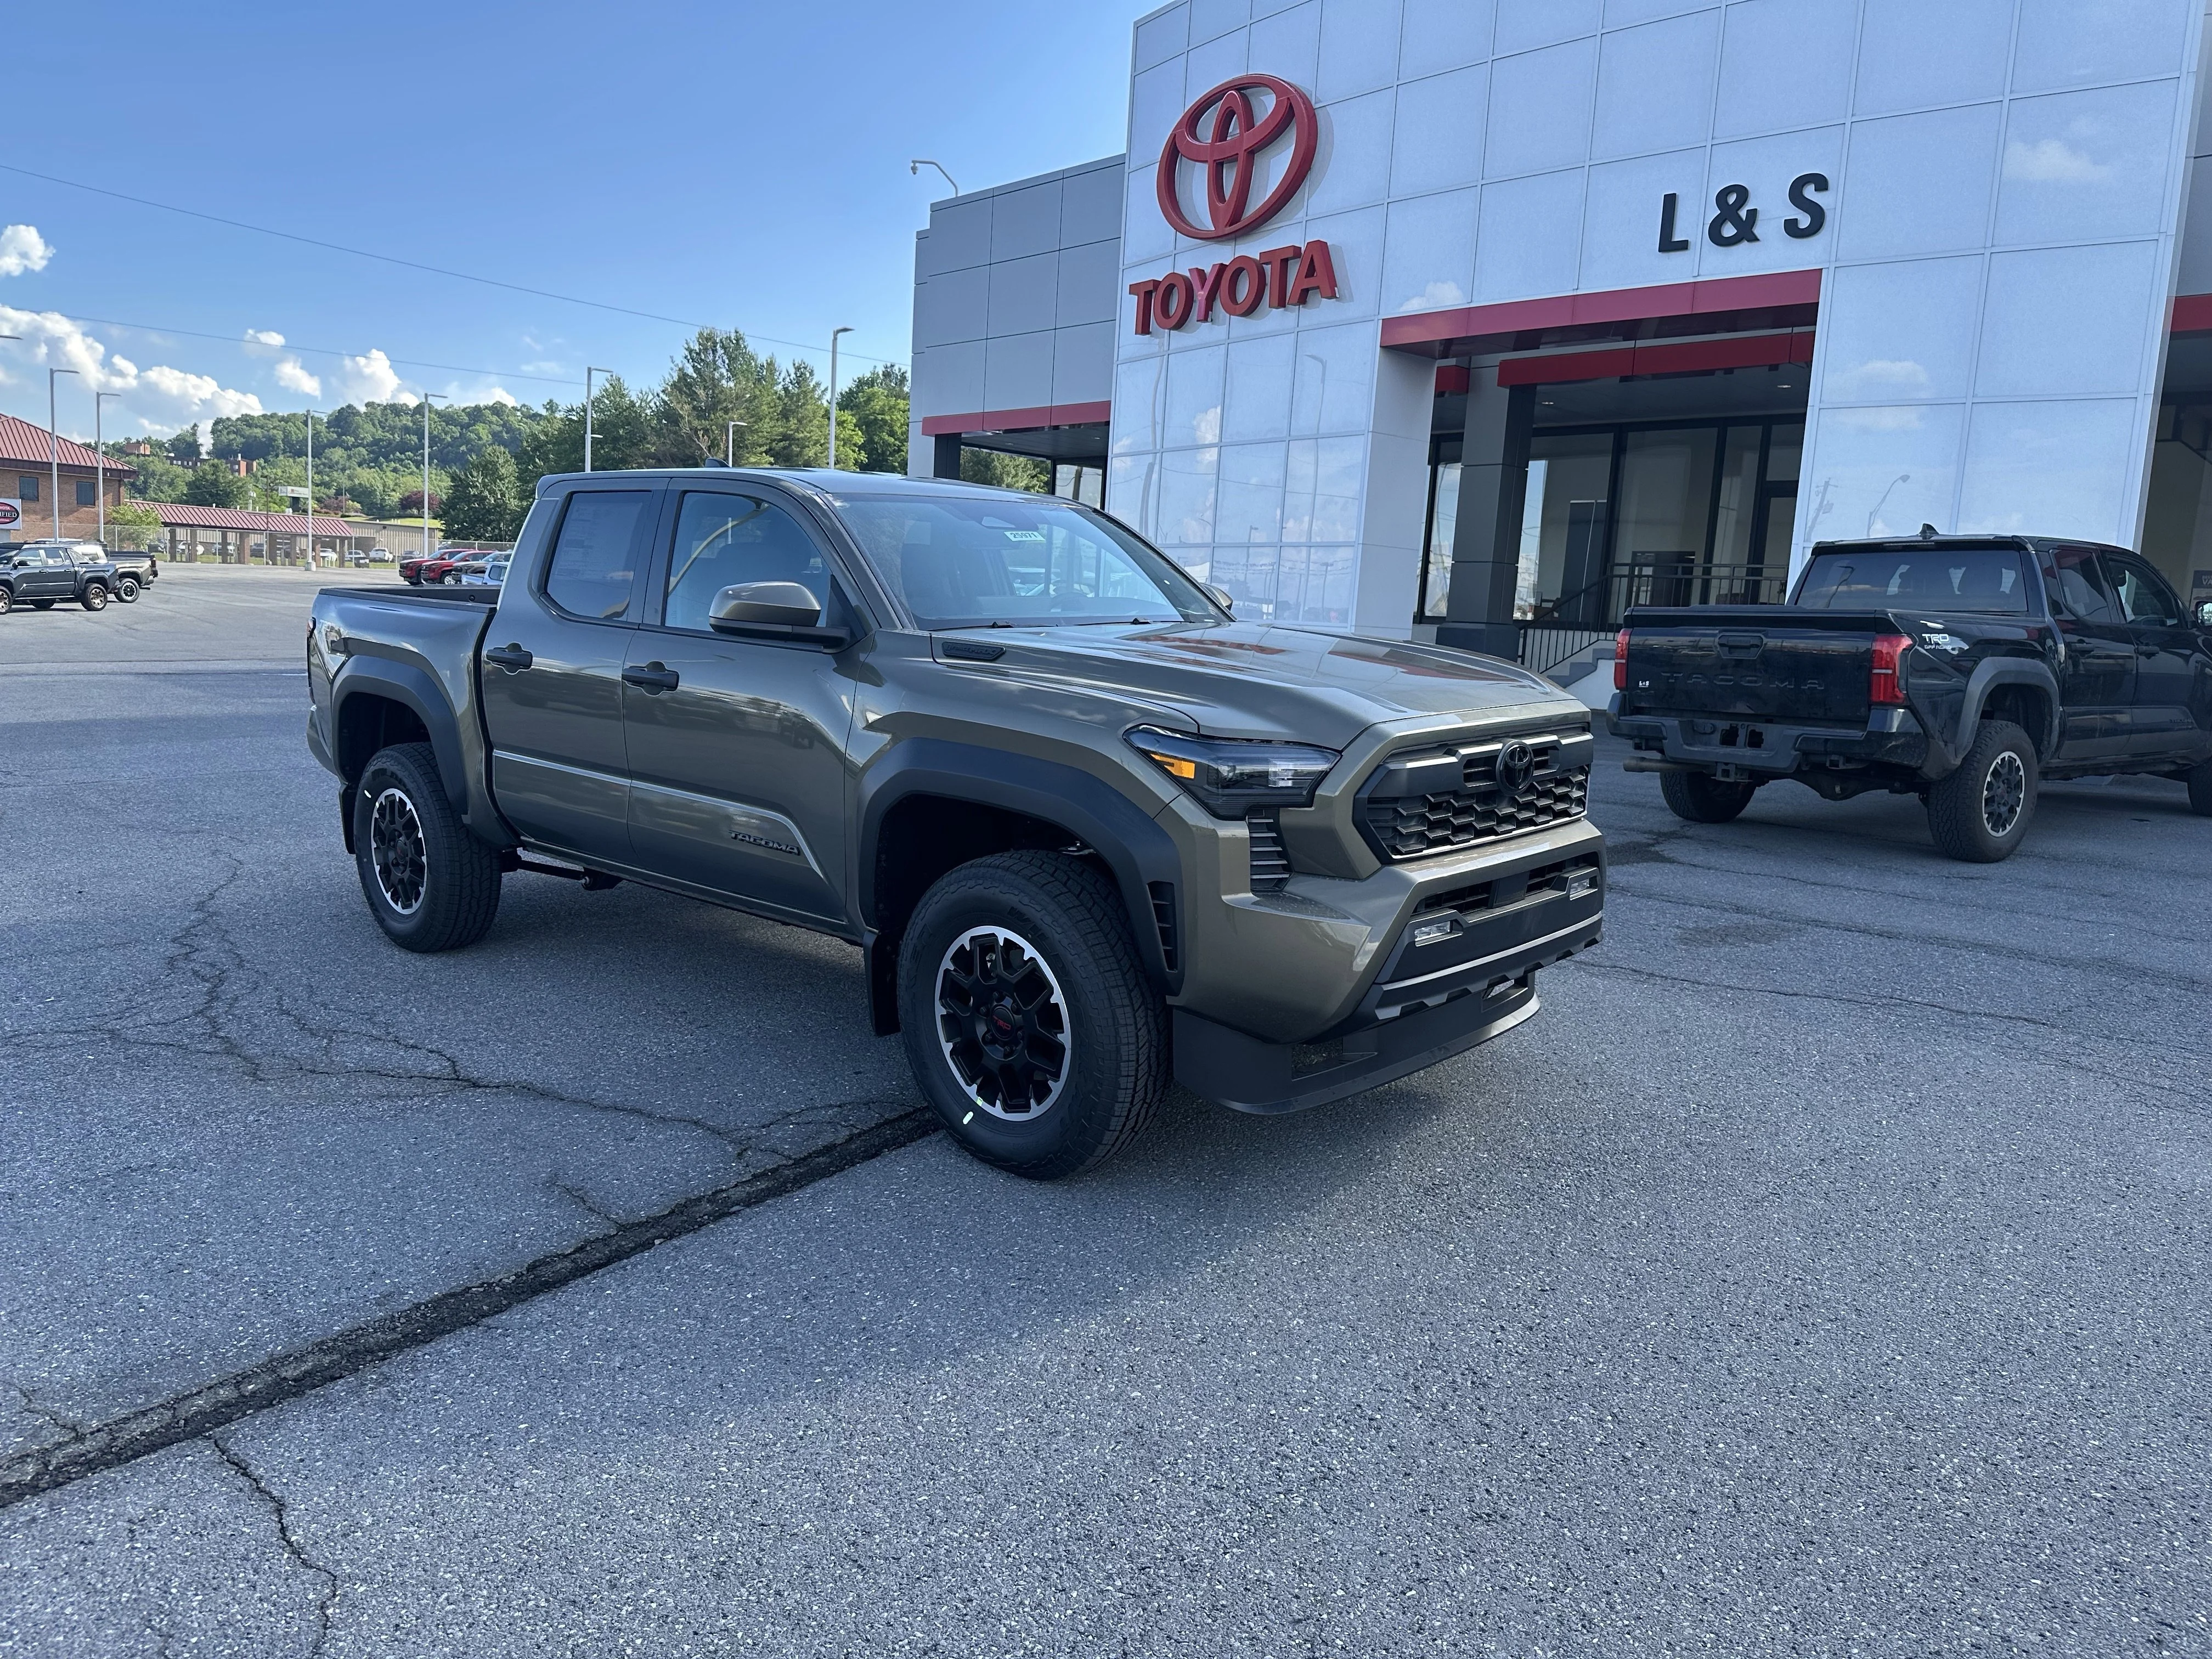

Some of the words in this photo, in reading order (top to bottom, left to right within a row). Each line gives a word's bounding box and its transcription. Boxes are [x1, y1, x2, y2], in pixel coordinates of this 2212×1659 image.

[1658, 193, 1689, 253] L
[1708, 184, 1760, 247] &
[1783, 172, 1829, 239] S
[1128, 239, 1340, 335] TOYOTA
[1922, 633, 1949, 645] TRD
[1661, 672, 1825, 690] TACOMA
[728, 829, 800, 856] TACOMA
